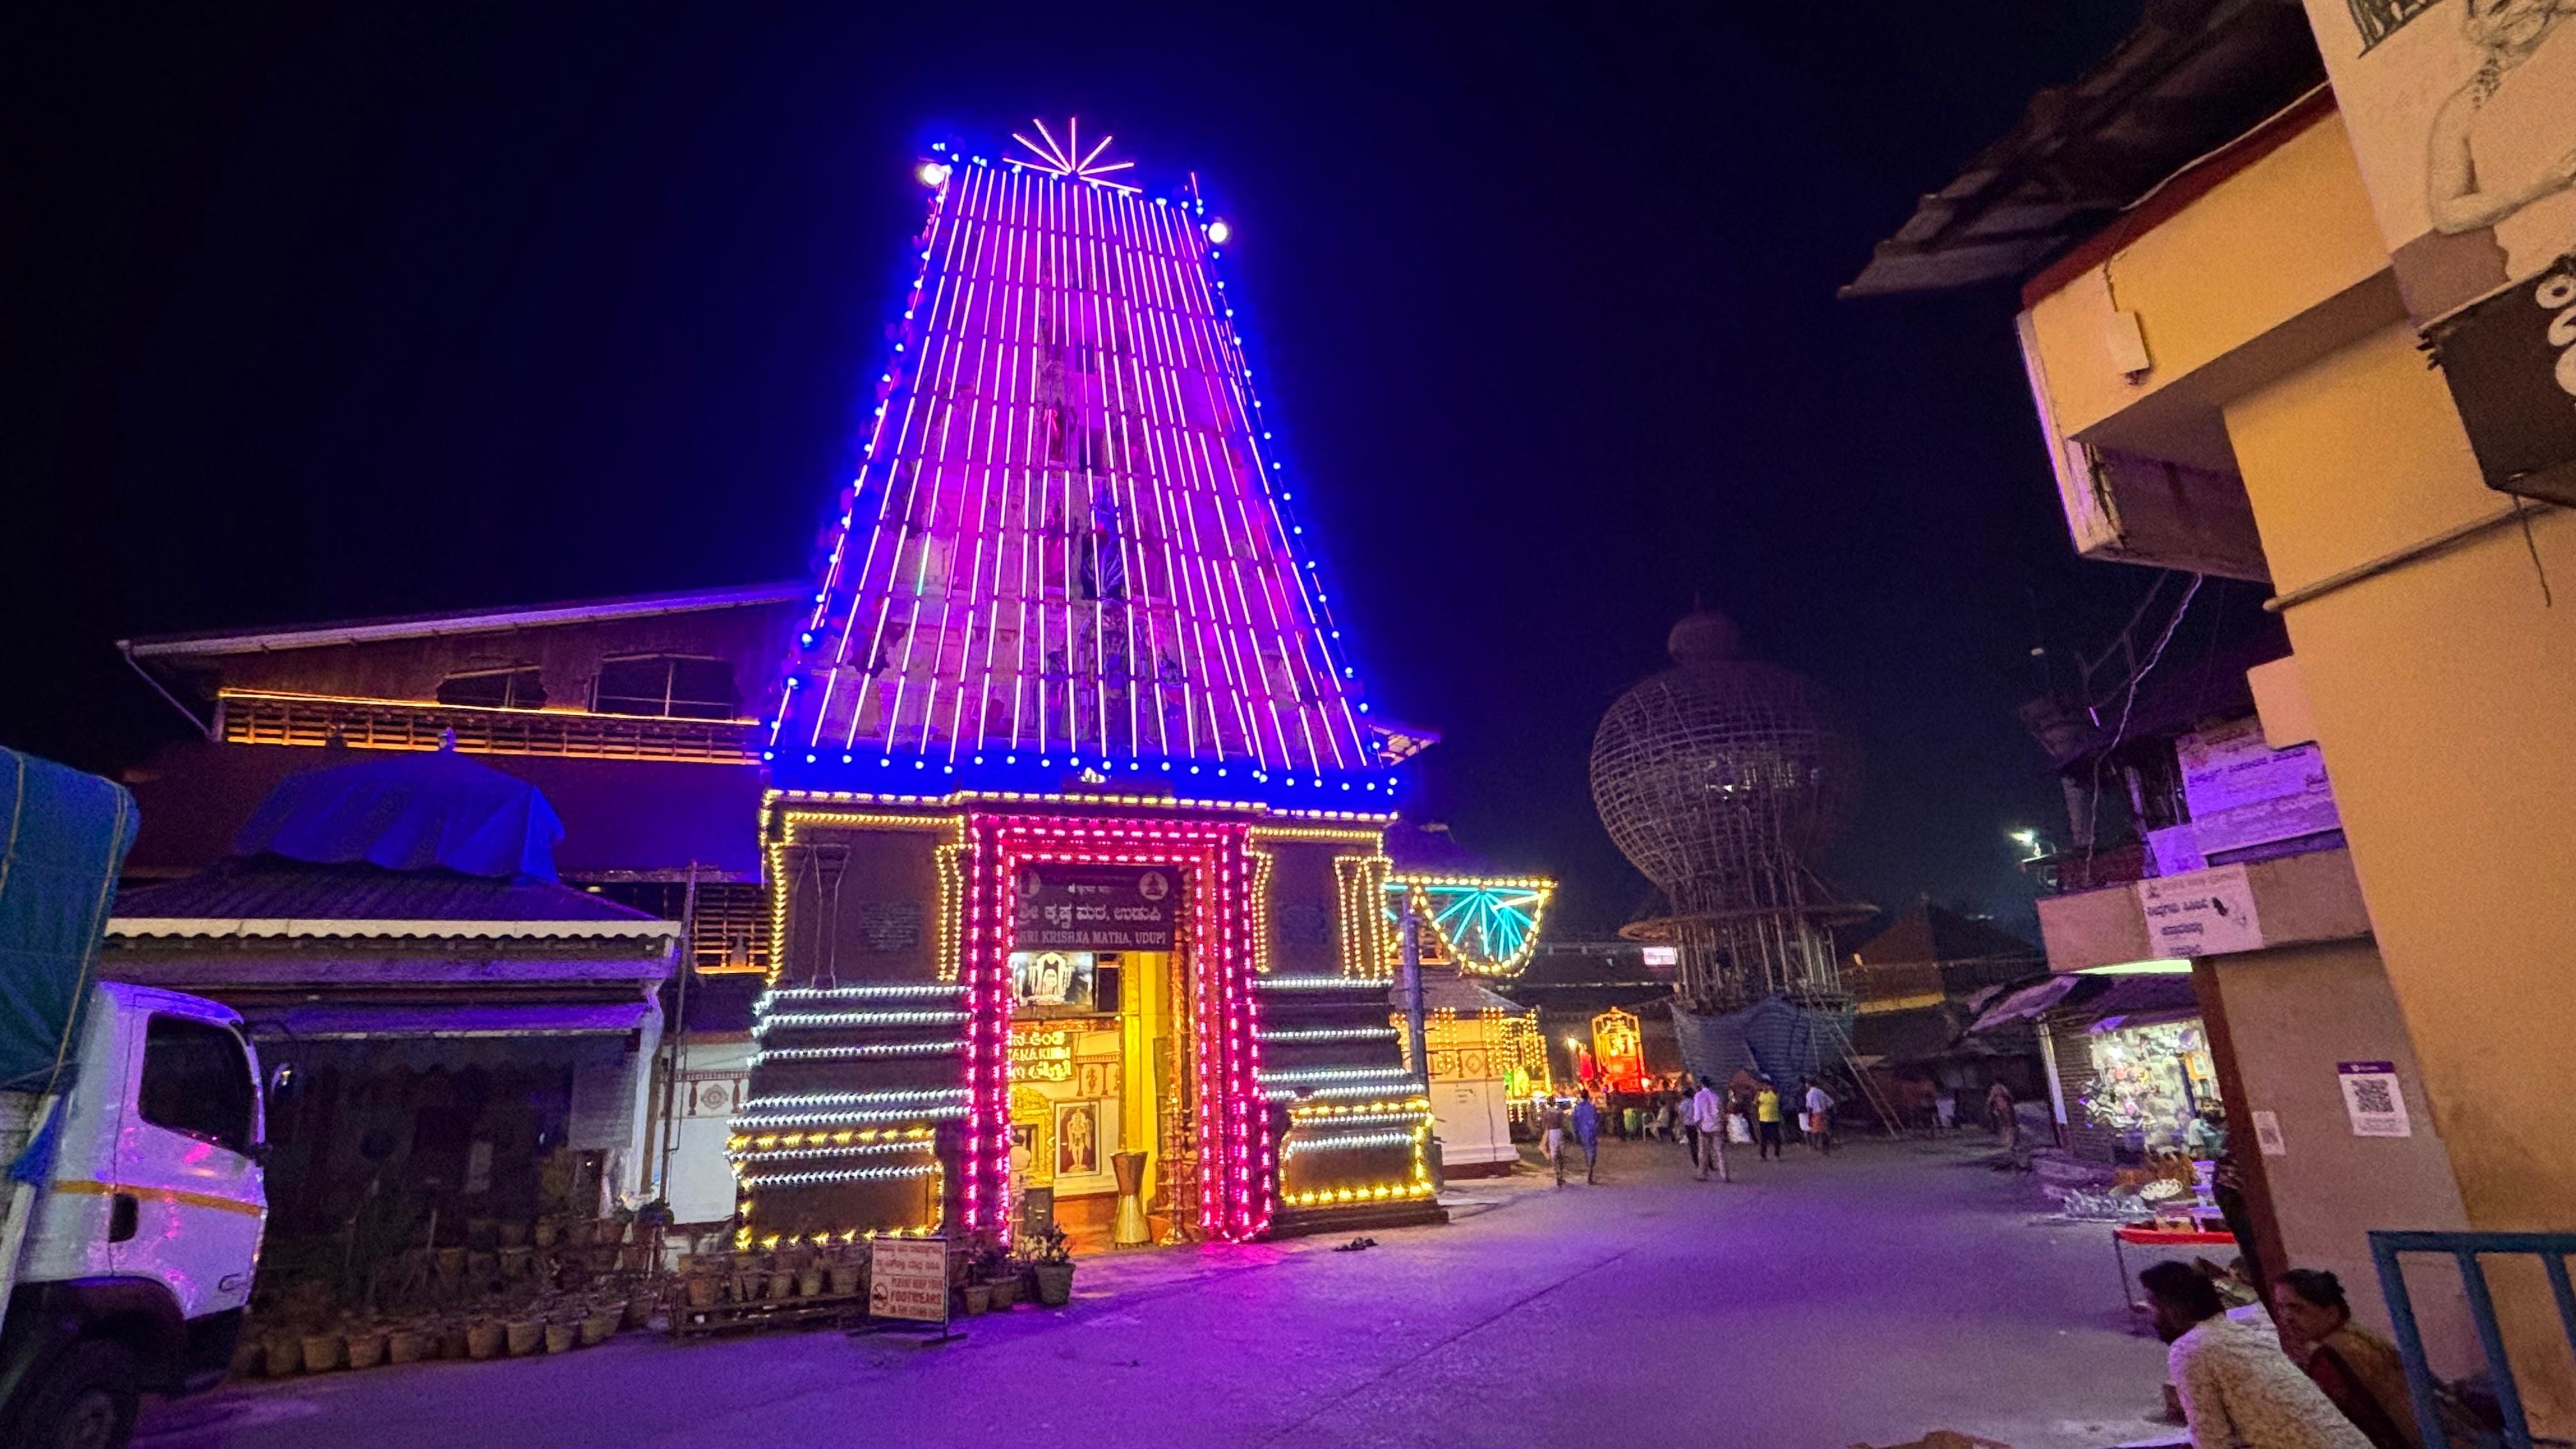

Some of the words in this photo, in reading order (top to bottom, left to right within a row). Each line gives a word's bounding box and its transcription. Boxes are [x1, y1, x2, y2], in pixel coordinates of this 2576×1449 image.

[1042, 930, 1089, 944] KRISHNA
[1135, 931, 1166, 945] UDUPI
[891, 1291, 942, 1305] FOOTWEARS
